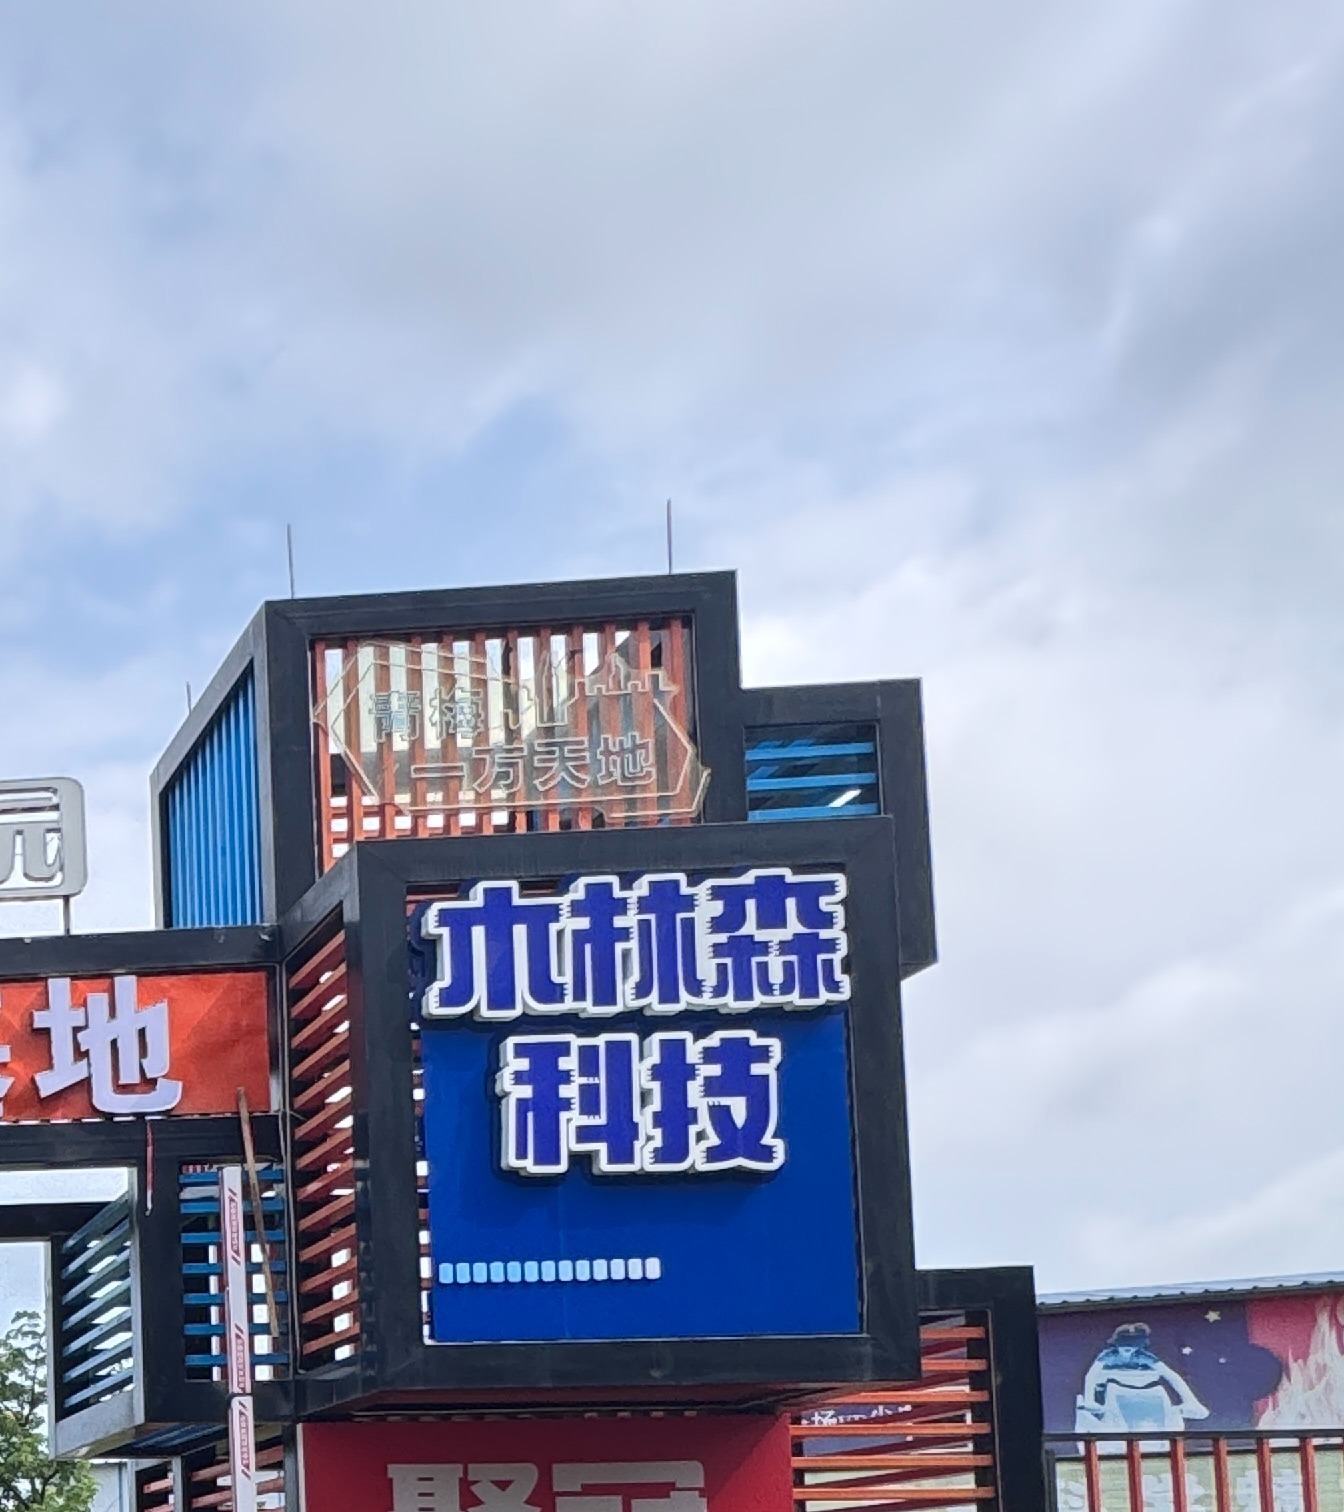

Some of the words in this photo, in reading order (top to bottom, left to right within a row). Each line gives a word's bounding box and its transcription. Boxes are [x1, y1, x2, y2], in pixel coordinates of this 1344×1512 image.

[412, 731, 657, 794] 一方天地
[420, 867, 851, 1023] 木林森
[494, 1029, 787, 1177] 科技
